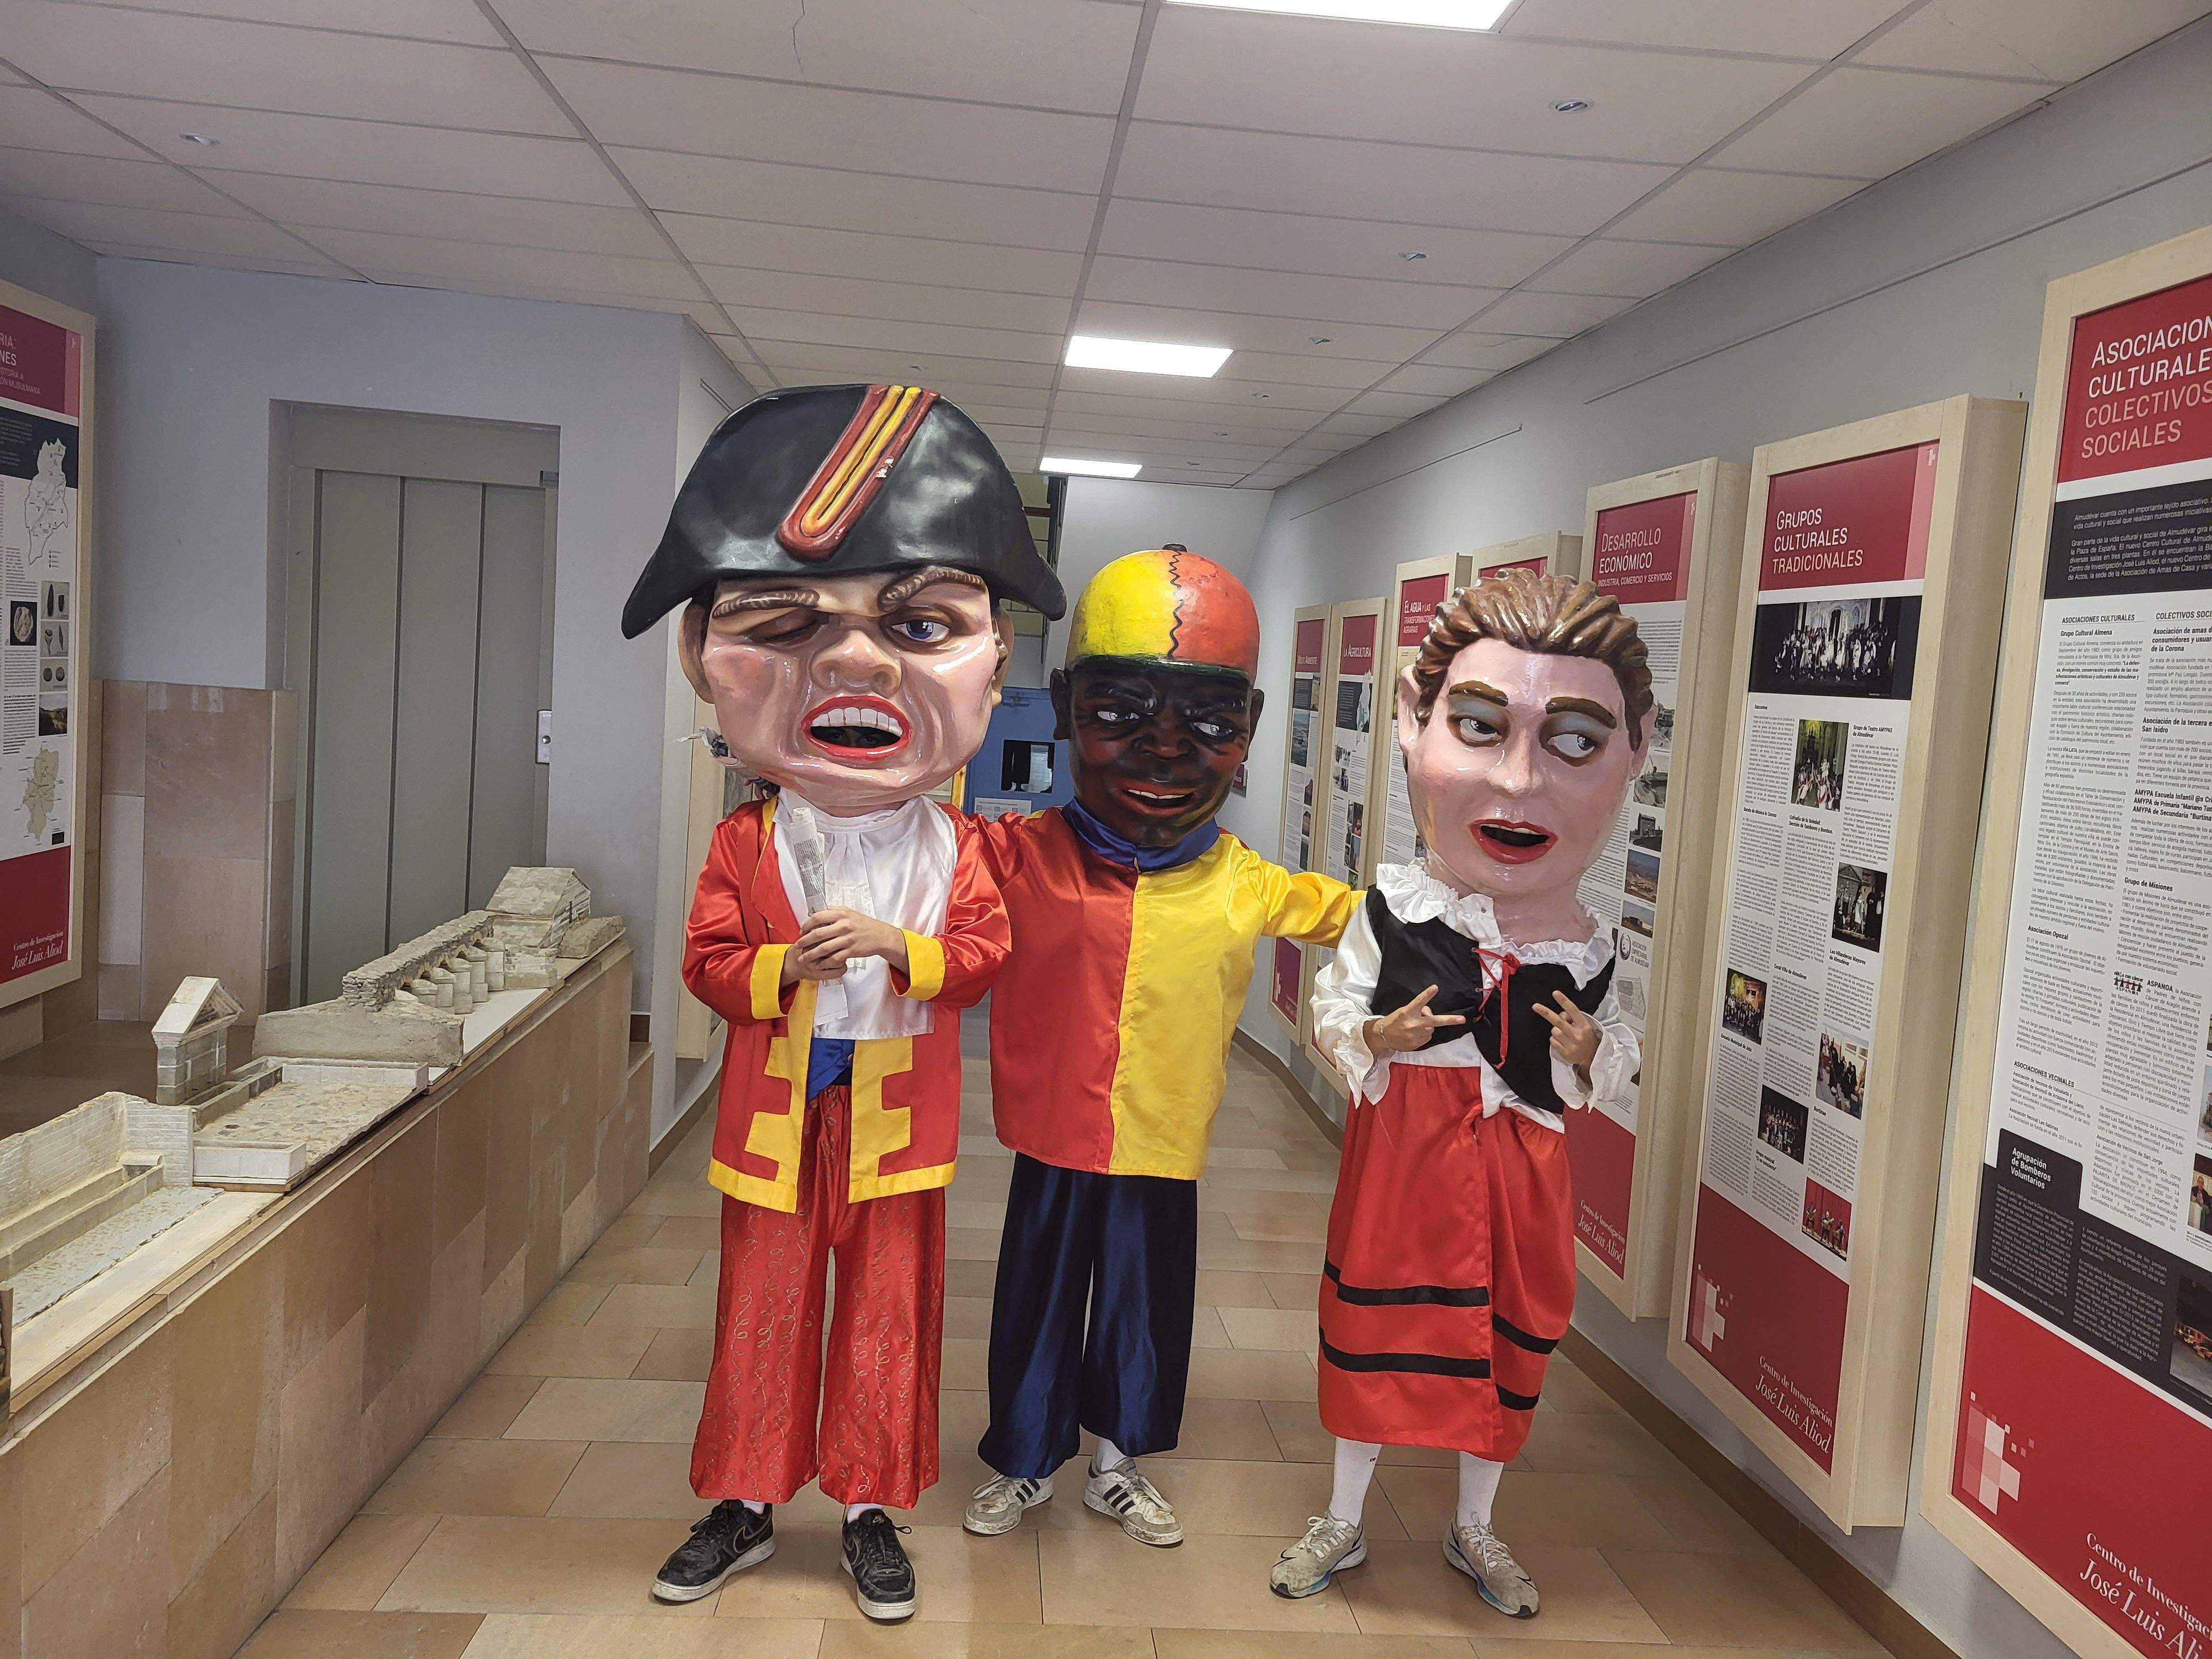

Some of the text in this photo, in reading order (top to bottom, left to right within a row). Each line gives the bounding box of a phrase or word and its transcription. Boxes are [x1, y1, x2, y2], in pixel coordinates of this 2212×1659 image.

[2085, 380, 2212, 429] COLECTIVOS
[2081, 419, 2182, 458] SOCIALES
[2073, 521, 2083, 530] vida
[2084, 520, 2102, 529] cultural
[2107, 517, 2121, 526] social
[2122, 517, 2132, 525] que
[2133, 514, 2153, 523] realizan
[2154, 510, 2184, 520] numerosas
[2184, 507, 2212, 517] iniciativas
[2135, 503, 2163, 513] importante
[2164, 501, 2179, 510] tejido
[1777, 508, 1822, 530] GRUPOS
[1601, 528, 1661, 552] DESARROLLO
[1774, 527, 1848, 552] CULTURALES
[2120, 533, 2138, 541] cultural
[2143, 531, 2158, 539] social
[2167, 527, 2196, 536] Almudévar
[2197, 525, 2208, 535] gira
[1599, 550, 1652, 574] ECONÓMICO
[1772, 549, 1863, 574] TRADICIONALES
[2091, 561, 2122, 570] Investigación
[2135, 557, 2145, 566] Luis
[2184, 554, 2203, 562] Centro
[1620, 576, 1643, 585] COMERCIO
[1644, 574, 1648, 583] Y
[1648, 572, 1673, 582] SERVICIOS
[1404, 601, 1410, 614] EL
[1410, 601, 1422, 613] AGUA
[2156, 611, 2195, 619] COLECTIVOS
[2153, 627, 2183, 635] Asociación
[2142, 717, 2172, 725] Asociación
[2133, 797, 2152, 806] AMYPA
[2160, 800, 2180, 808] Primaria
[2134, 789, 2153, 797] AMYPA
[2154, 791, 2174, 799] Escuela
[2175, 792, 2194, 801] Infantil
[2132, 806, 2152, 814] AMYPA
[2159, 809, 2189, 818] Secundaria
[2124, 877, 2173, 891] Grupo de Misiones
[2028, 925, 2069, 940] Asociación Opozal
[12, 940, 64, 970] José Luis Aliod
[2147, 979, 2173, 993] ASPANOA
[2014, 1060, 2074, 1088] ASOCIACIONES VECINALES
[2011, 1157, 2051, 1182] de Bomberos
[2012, 1147, 2047, 1170] Agrupación
[2011, 1166, 2046, 1190] Voluntarios
[1578, 1214, 1625, 1265] José Luis Aliod
[1760, 1355, 1833, 1427] Centro de Investigación
[1755, 1374, 1832, 1453] José Luis Aliod
[2086, 1532, 2126, 1573] Centro
[2129, 1566, 2144, 1587] de
[2080, 1558, 2122, 1604] José
[2120, 1589, 2165, 1641] Luis
